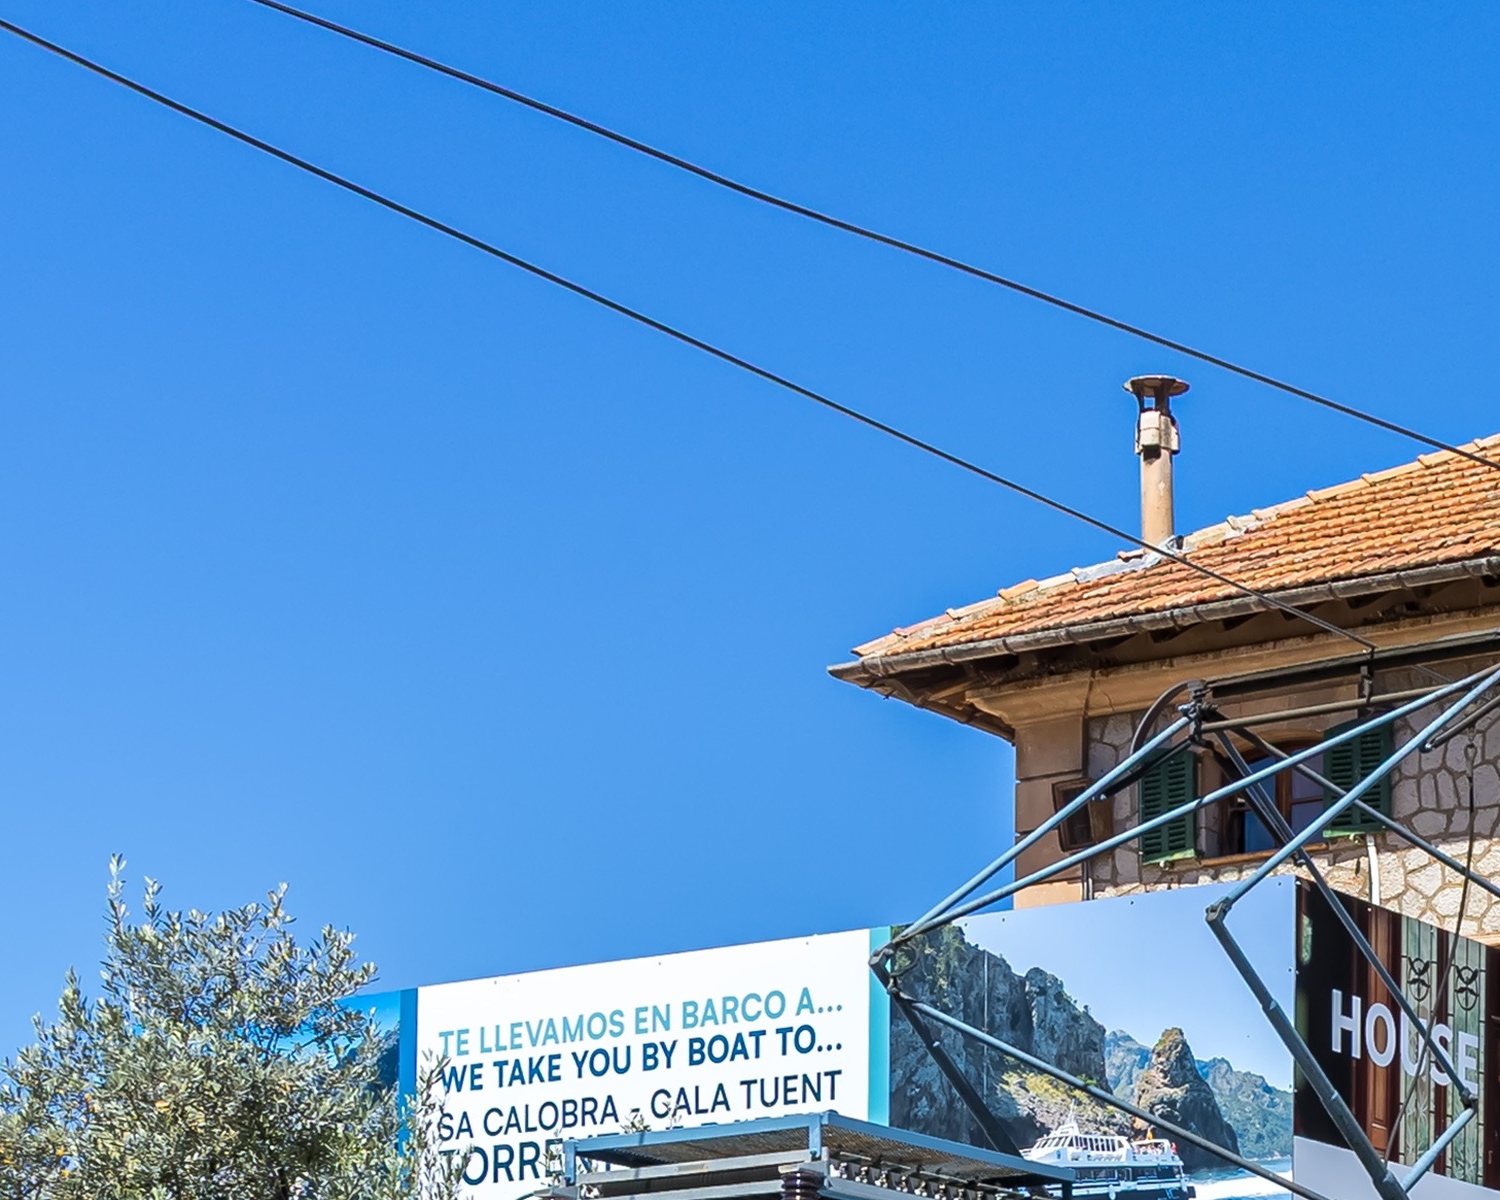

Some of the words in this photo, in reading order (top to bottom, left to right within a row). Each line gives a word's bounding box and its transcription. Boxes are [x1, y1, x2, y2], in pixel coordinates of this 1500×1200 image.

[439, 1030, 470, 1057] TE
[479, 1007, 625, 1054] LLEVAMOS
[635, 1003, 671, 1035] EN
[682, 989, 787, 1028] BARCO
[795, 986, 843, 1015] A...
[1331, 988, 1479, 1096] HOUSE
[441, 1062, 484, 1094] WE
[493, 1052, 562, 1089] TAKE
[571, 1045, 632, 1079] YOU
[643, 1040, 679, 1071] BY
[689, 1029, 766, 1066] BOAT
[776, 1024, 843, 1056] TO...
[441, 1109, 474, 1142] SA
[483, 1094, 620, 1137] CALOBRA
[650, 1082, 731, 1120] CALA
[739, 1069, 843, 1109] TUENT
